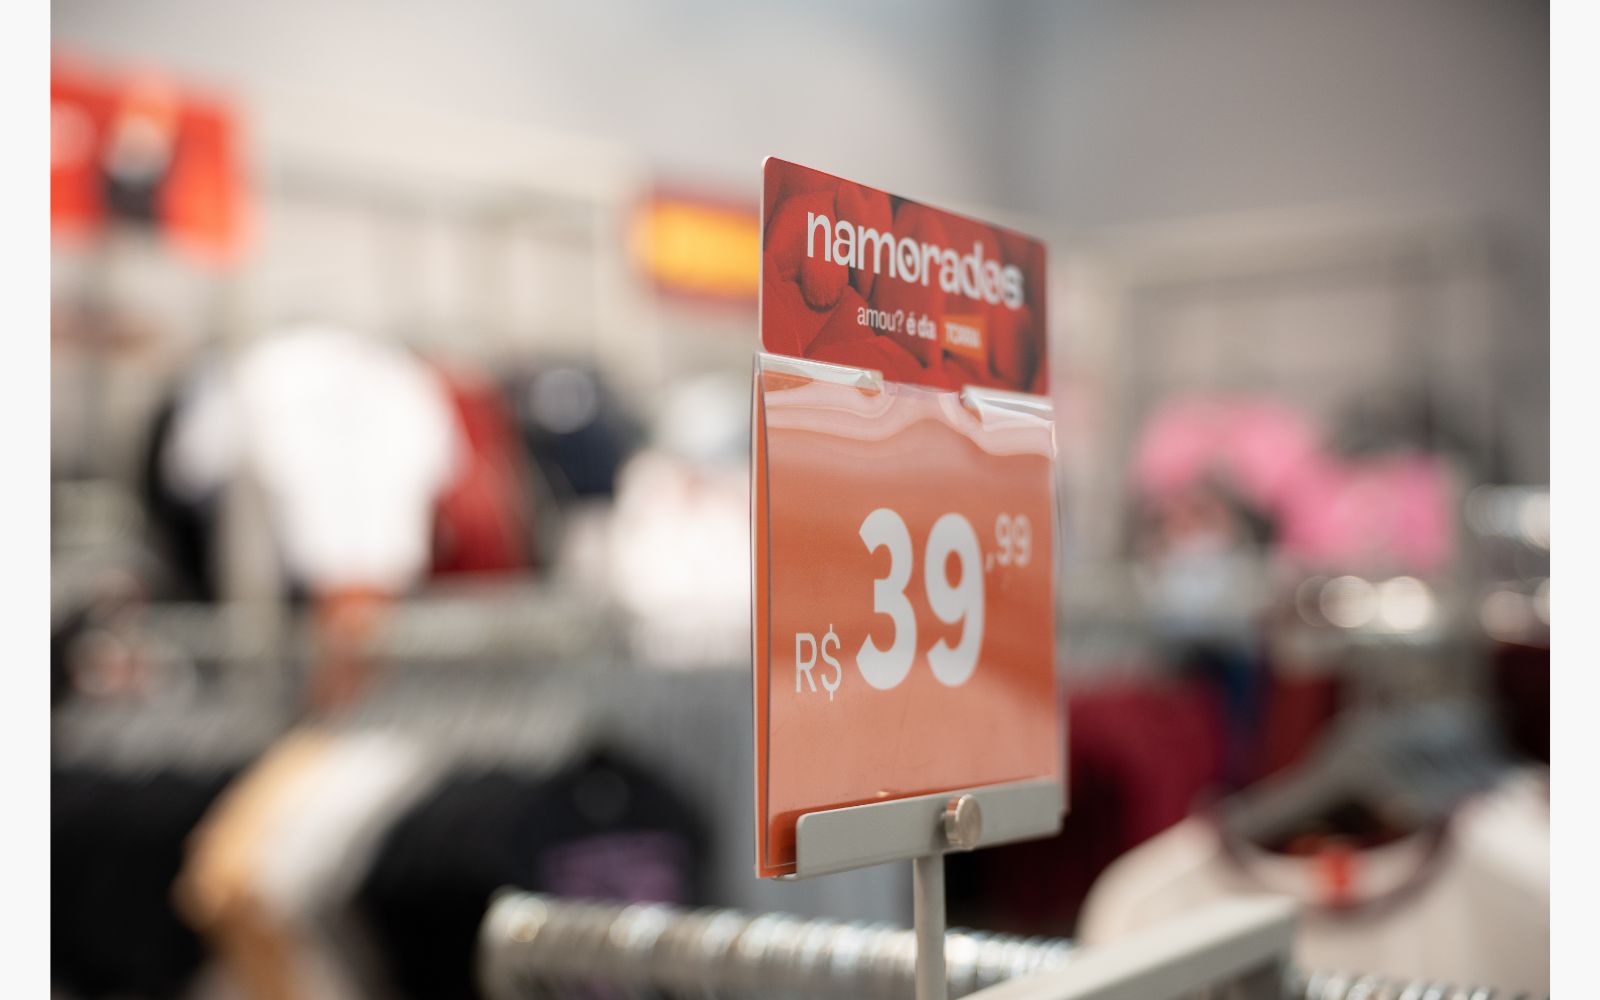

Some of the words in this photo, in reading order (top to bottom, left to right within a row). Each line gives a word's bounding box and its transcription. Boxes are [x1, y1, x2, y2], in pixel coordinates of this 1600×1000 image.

[807, 211, 1024, 310] namorados
[857, 306, 904, 334] amou?
[906, 310, 917, 337] é
[918, 313, 937, 341] da
[795, 623, 842, 702] R$
